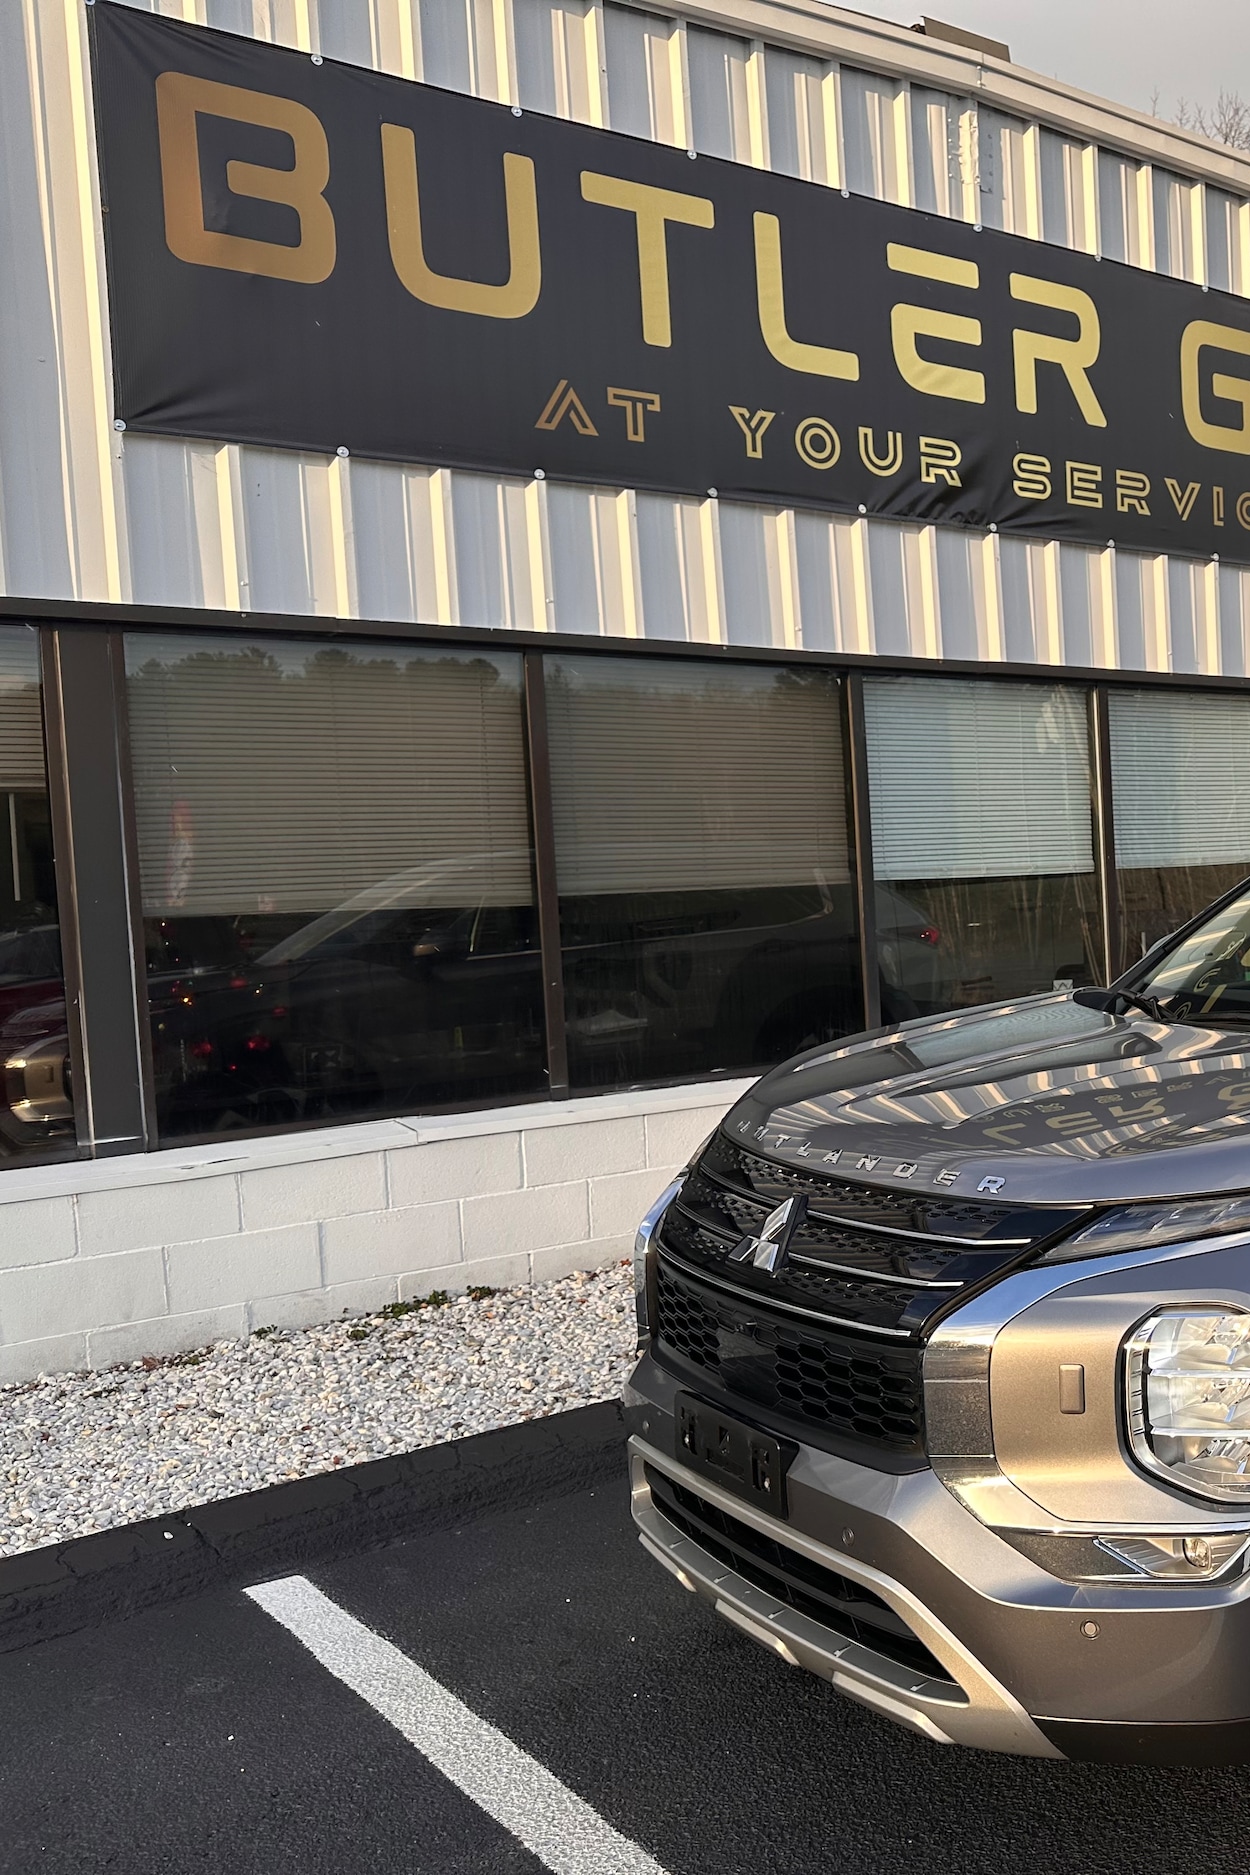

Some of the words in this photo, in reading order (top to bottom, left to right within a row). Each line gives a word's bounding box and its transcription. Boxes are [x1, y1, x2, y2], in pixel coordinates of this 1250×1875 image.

[155, 71, 1107, 427] BUTLER
[535, 379, 660, 442] AT
[728, 405, 962, 488] YOUR
[737, 1119, 1007, 1194] OUTLANDER
